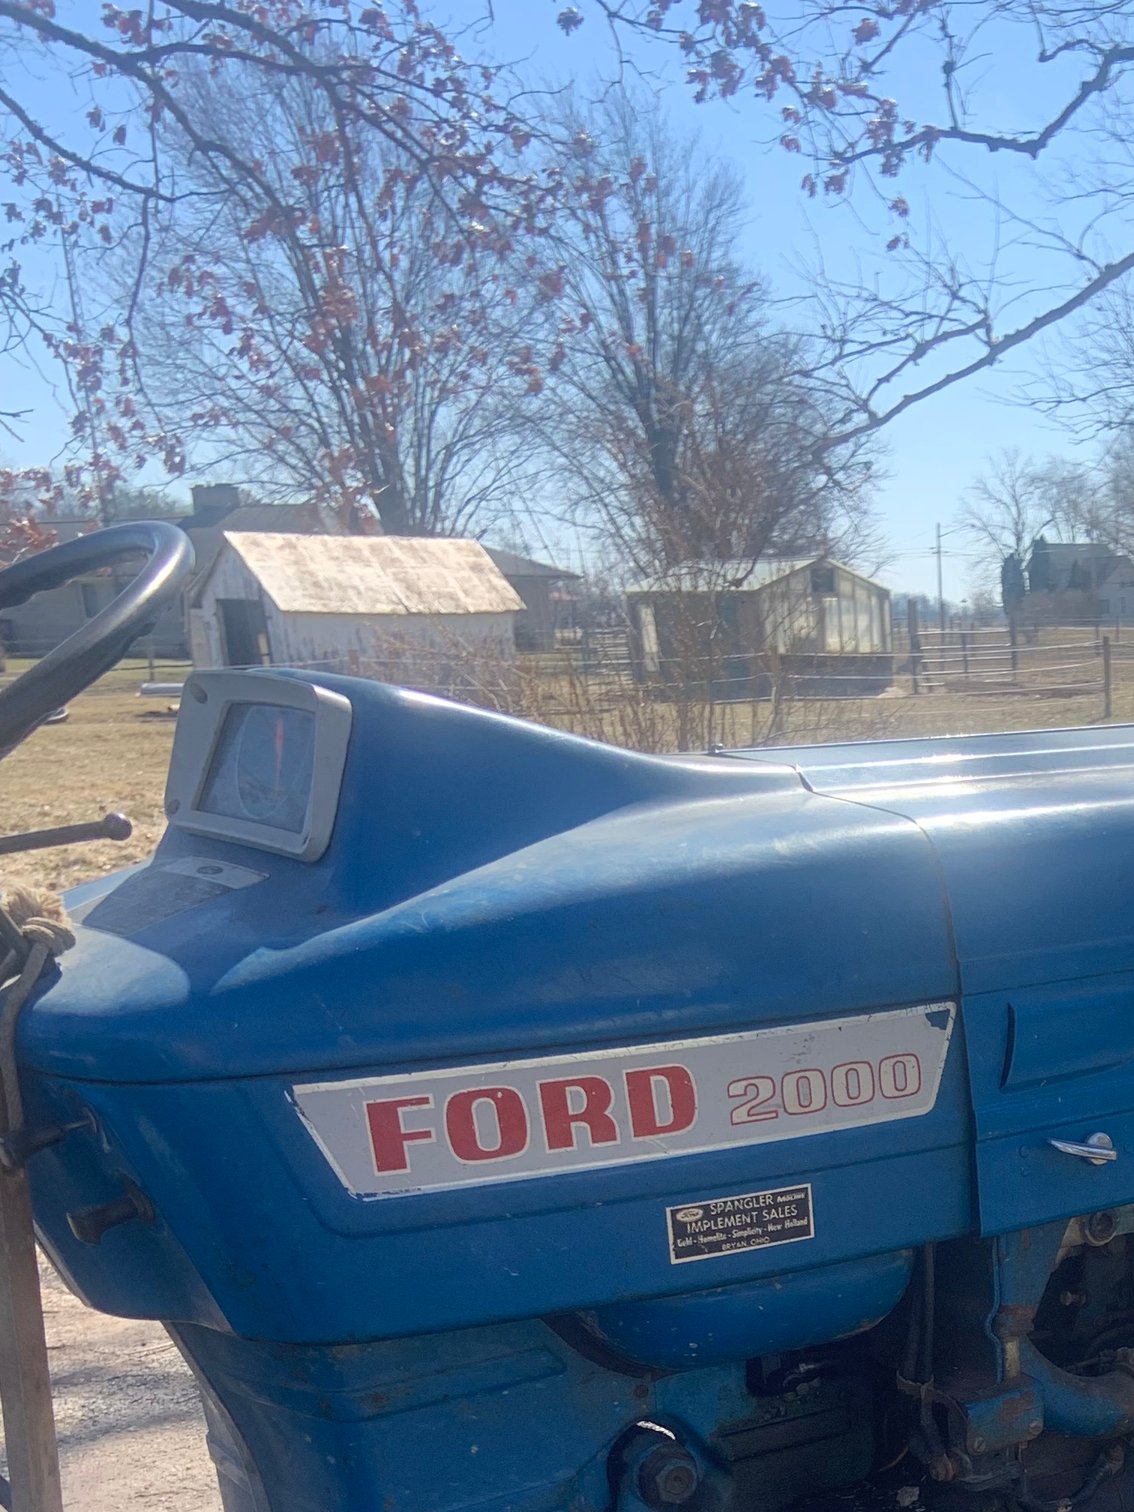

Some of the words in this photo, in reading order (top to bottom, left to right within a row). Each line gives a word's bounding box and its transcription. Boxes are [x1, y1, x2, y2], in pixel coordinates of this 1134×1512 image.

[364, 1063, 698, 1177] FORD
[726, 1053, 922, 1126] 2000
[710, 1194, 774, 1215] SPANGLER
[687, 1211, 758, 1234] IMPLEMENT
[762, 1204, 798, 1221] SALES
[732, 1227, 763, 1239] Simplicity
[768, 1222, 783, 1232] New
[784, 1217, 808, 1229] Holland
[750, 1236, 770, 1246] OHIO
